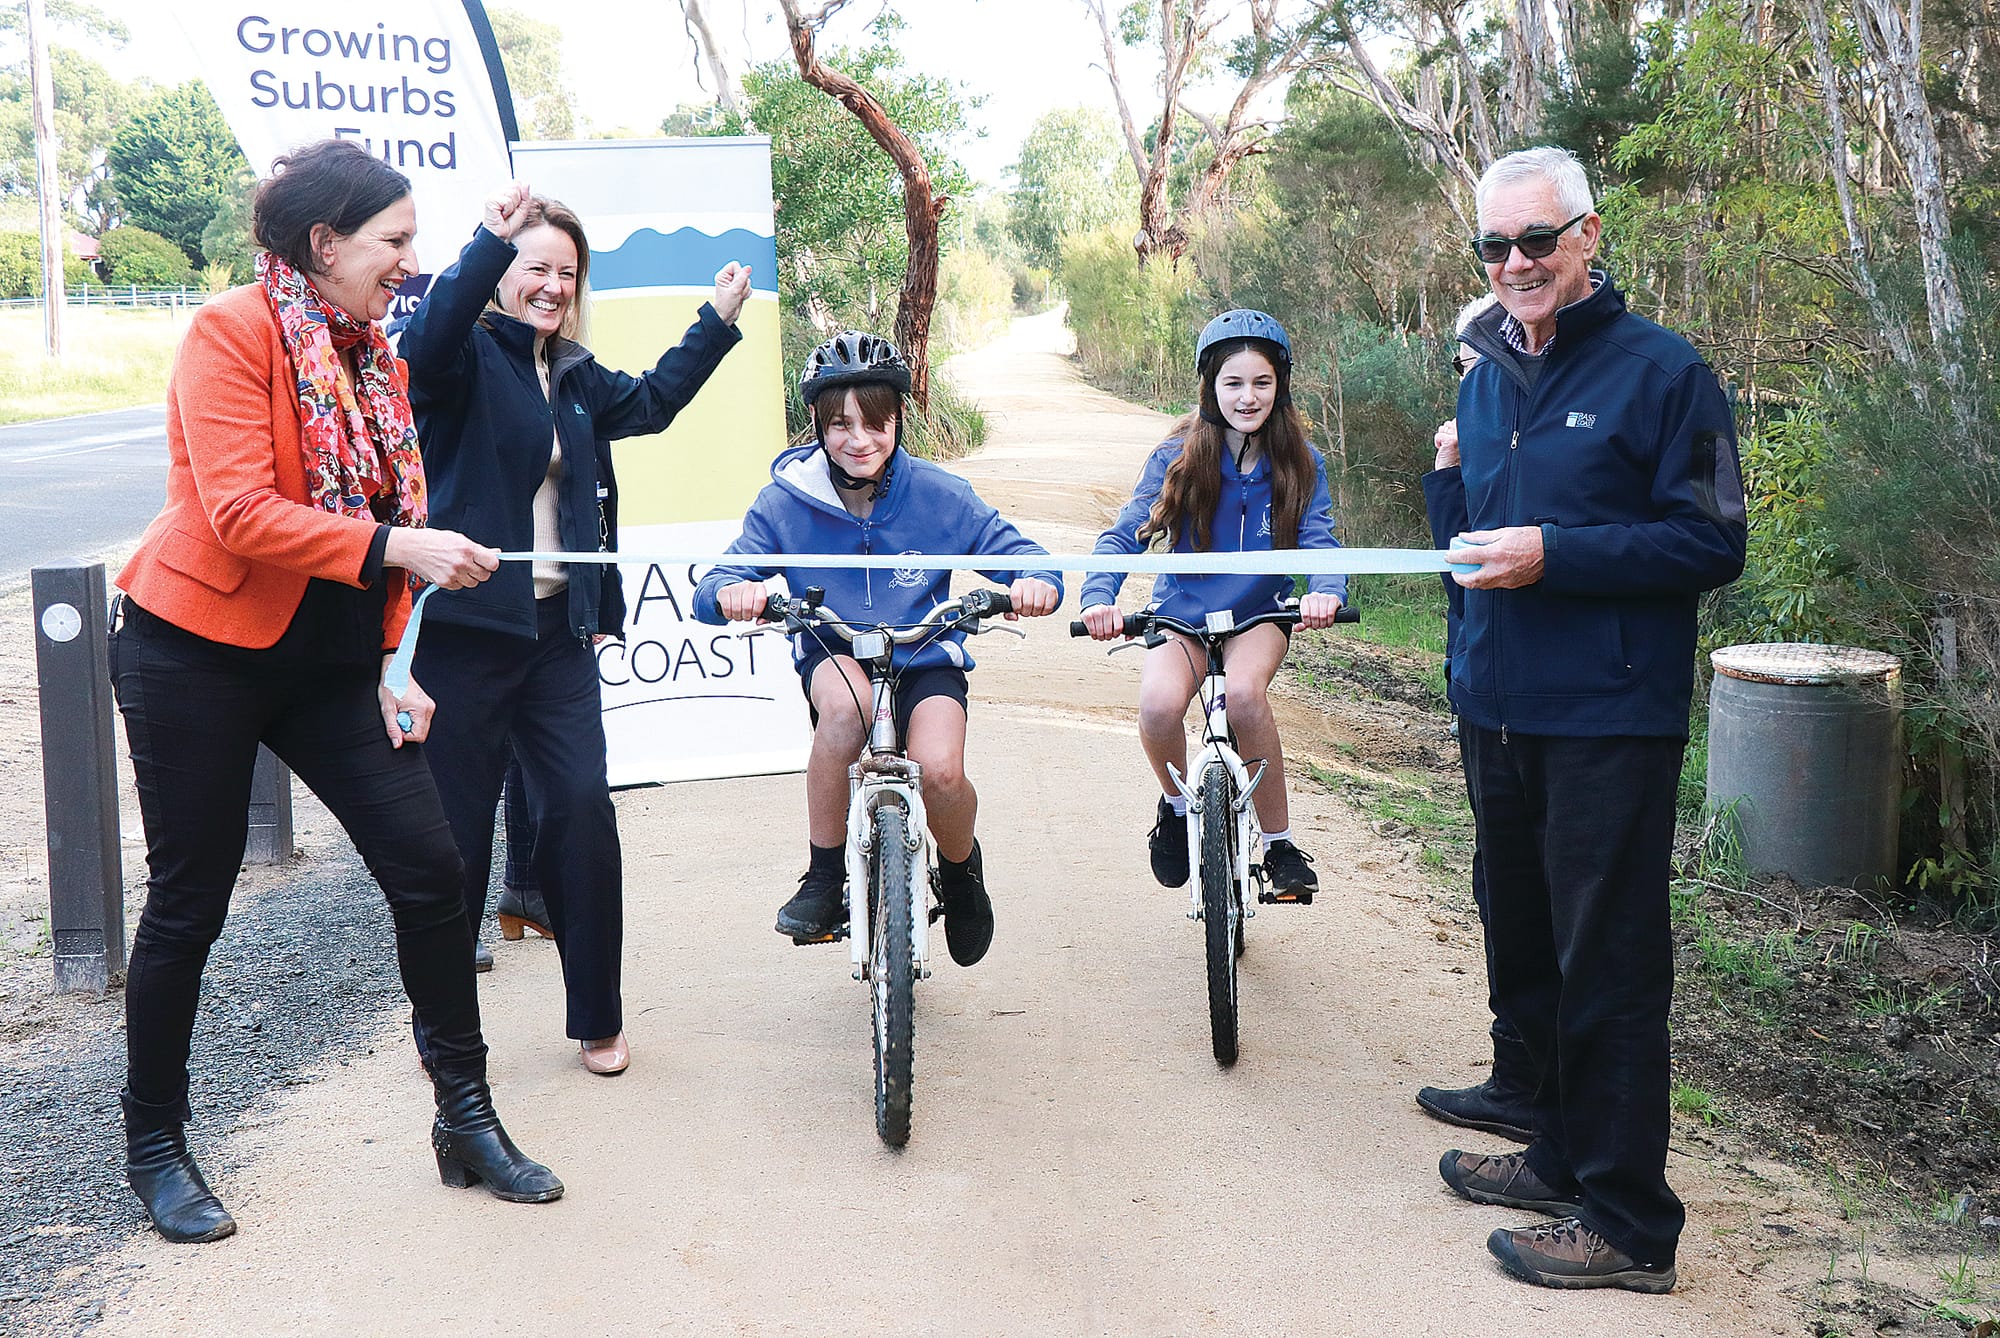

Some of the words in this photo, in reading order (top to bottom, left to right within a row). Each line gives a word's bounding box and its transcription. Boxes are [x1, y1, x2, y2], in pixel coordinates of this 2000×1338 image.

[237, 15, 450, 74] Growing
[250, 69, 456, 118] Suburbs
[1577, 412, 1597, 422] BASS
[598, 633, 764, 686] COAST
